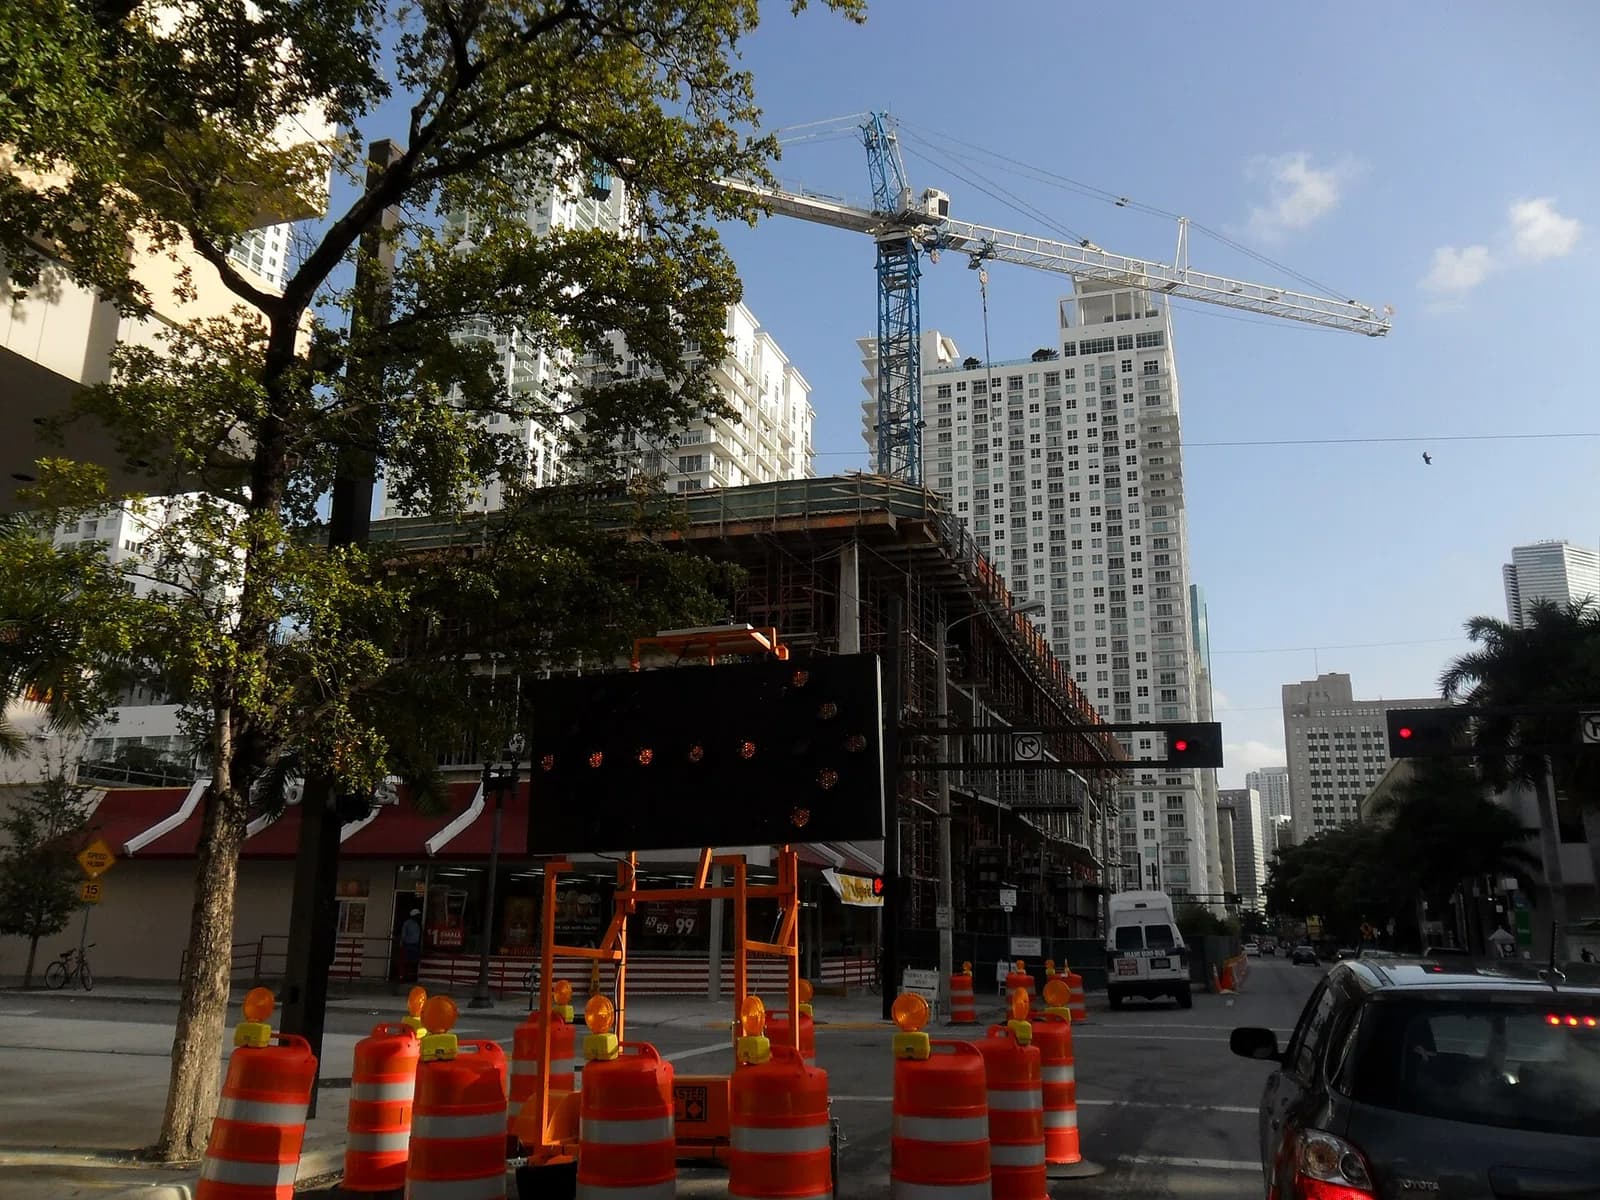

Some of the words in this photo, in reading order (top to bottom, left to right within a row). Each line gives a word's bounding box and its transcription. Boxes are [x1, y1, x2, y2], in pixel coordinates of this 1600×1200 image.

[86, 884, 98, 895] 15
[656, 923, 669, 934] 59
[675, 918, 696, 935] 99
[1400, 1178, 1441, 1191] TOYOTA
